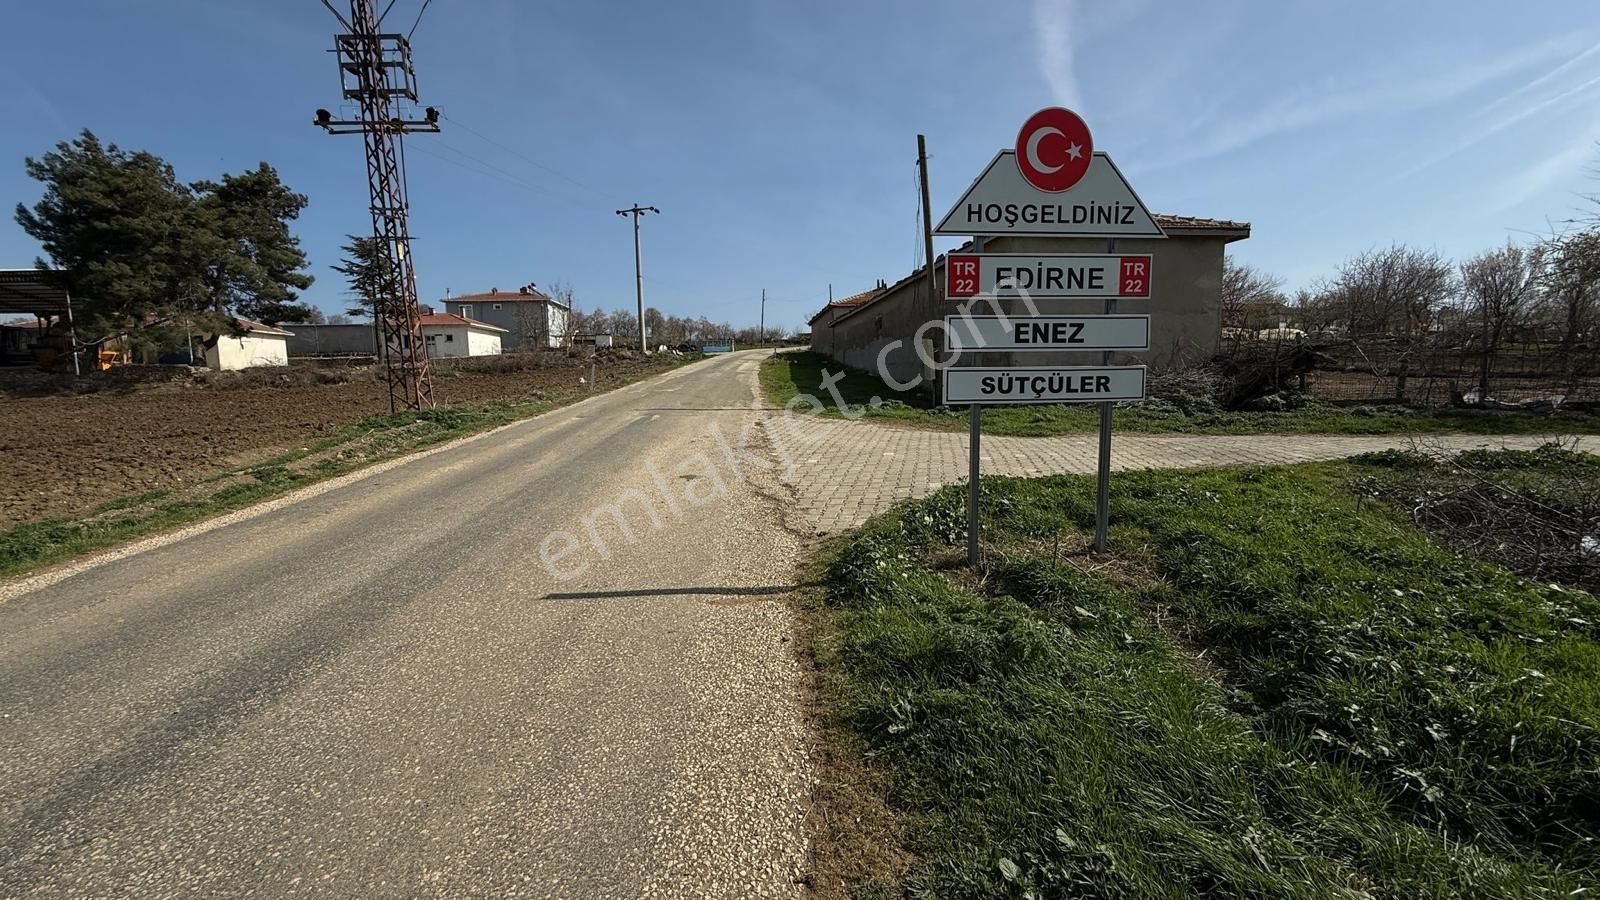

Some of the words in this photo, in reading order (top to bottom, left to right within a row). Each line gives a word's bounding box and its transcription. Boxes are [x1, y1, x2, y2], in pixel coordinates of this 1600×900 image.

[967, 201, 1135, 227] HOŞGELDİNİZ
[953, 262, 976, 276] TR
[995, 262, 1105, 290] EDİRNE
[1124, 262, 1145, 276] TR
[955, 280, 974, 293] 22
[1125, 279, 1143, 293] 22
[1014, 322, 1085, 344] ENEZ
[980, 373, 1112, 398] SÜTÇÜLER
